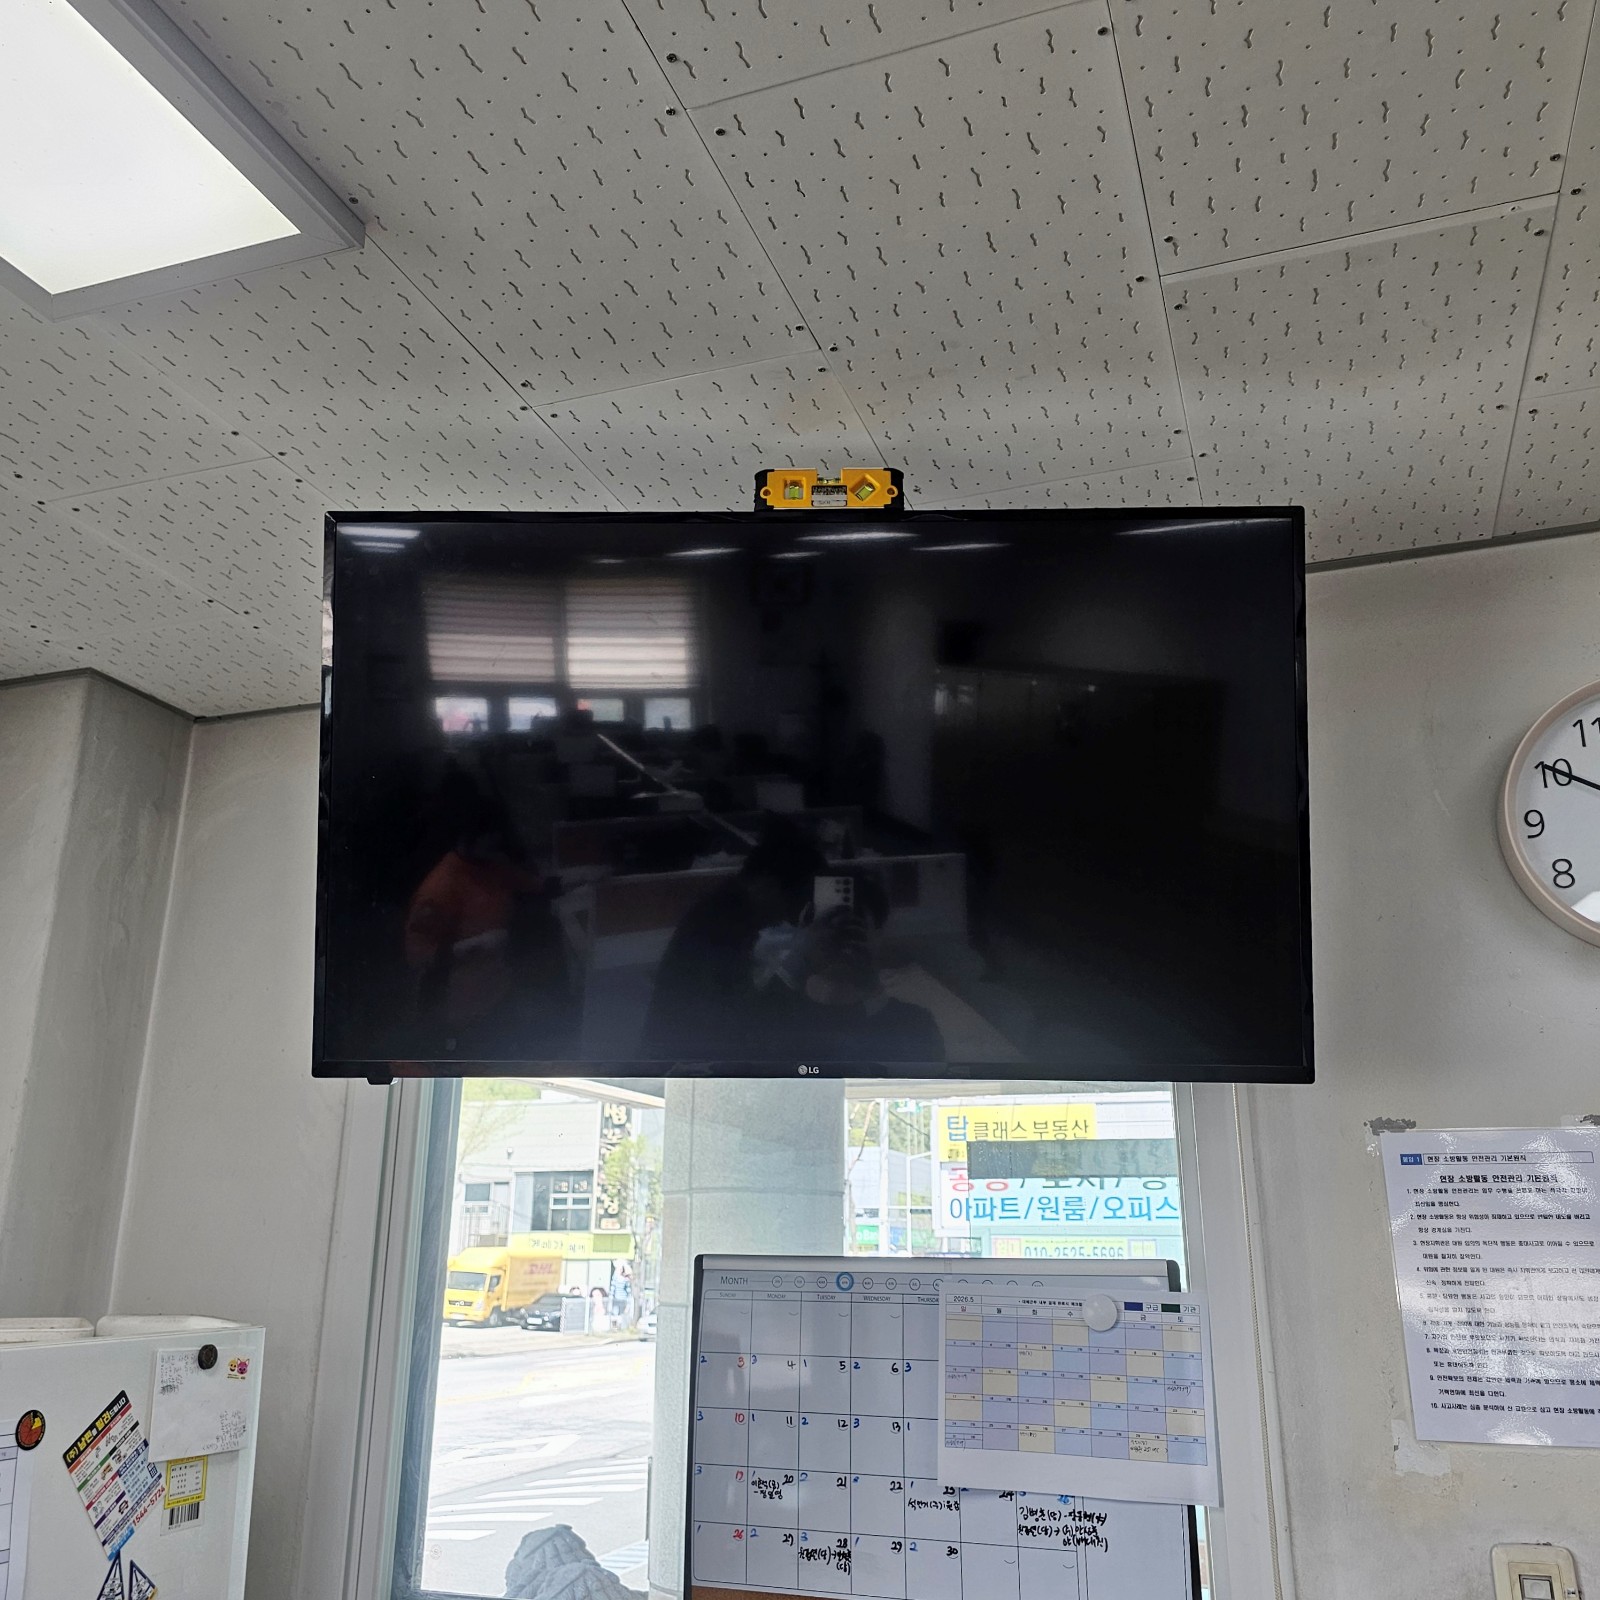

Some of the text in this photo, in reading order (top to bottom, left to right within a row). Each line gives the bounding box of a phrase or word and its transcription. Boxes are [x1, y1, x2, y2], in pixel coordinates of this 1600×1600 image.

[1534, 758, 1572, 788] 10
[1524, 810, 1544, 839] 9
[1552, 858, 1576, 889] 8
[947, 1116, 1088, 1141] 탑 클래스 부동산
[1458, 1174, 1488, 1183] 소방활동
[1492, 1174, 1523, 1183] 안전관리
[950, 1196, 1179, 1222] 아파트/원룸/오피스
[721, 1276, 748, 1285] MONTH
[751, 1355, 757, 1364] 3
[787, 1360, 796, 1369] 4
[839, 1361, 847, 1370] 5
[891, 1362, 899, 1372] 6
[905, 1363, 912, 1372] 3
[697, 1411, 703, 1421] 3
[735, 1413, 744, 1423] 10
[786, 1417, 793, 1425] 11
[801, 1417, 808, 1426] 2
[838, 1419, 848, 1429] 12
[854, 1418, 860, 1428] 3
[892, 1422, 900, 1432] 13
[696, 1466, 702, 1475] 3
[782, 1474, 794, 1485] 20
[837, 1476, 847, 1487] 21
[890, 1481, 903, 1491] 22
[132, 1485, 166, 1527] 1544-5724
[750, 1528, 759, 1538] 2
[801, 1532, 808, 1541] 3
[836, 1538, 848, 1548] 28
[891, 1541, 903, 1551] 29
[910, 1542, 918, 1551] 2
[946, 1546, 958, 1556] 30
